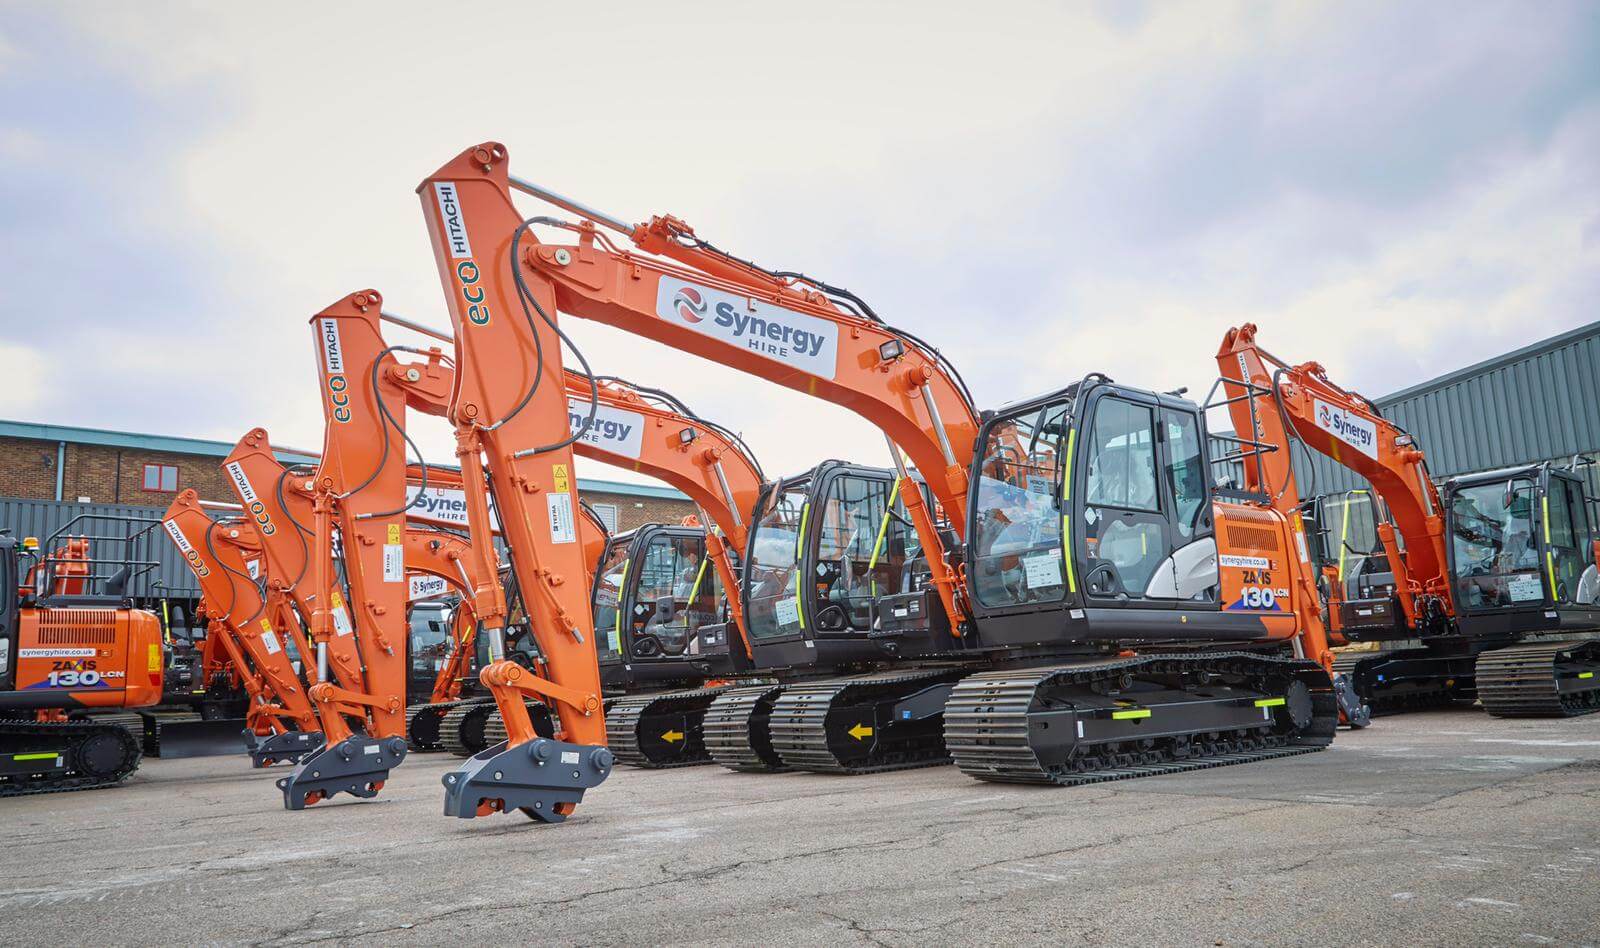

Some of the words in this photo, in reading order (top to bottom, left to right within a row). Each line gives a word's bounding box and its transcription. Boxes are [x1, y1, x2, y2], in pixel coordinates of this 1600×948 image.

[440, 186, 466, 254] HITACHI
[714, 301, 825, 357] Synergy
[324, 321, 340, 370] HITACHI
[748, 338, 788, 357] HIRE
[1333, 413, 1372, 445] Synergy
[230, 464, 254, 500] HITACHI
[437, 512, 466, 521] HIRE
[1221, 556, 1267, 566] synergyhire.co.uk
[1242, 568, 1271, 585] ZAXIS
[420, 580, 443, 593] Synergy
[1240, 586, 1275, 610] 130
[22, 649, 93, 657] synergyhire.co.uk
[52, 658, 97, 671] ZAXIS
[47, 670, 100, 687] 130
